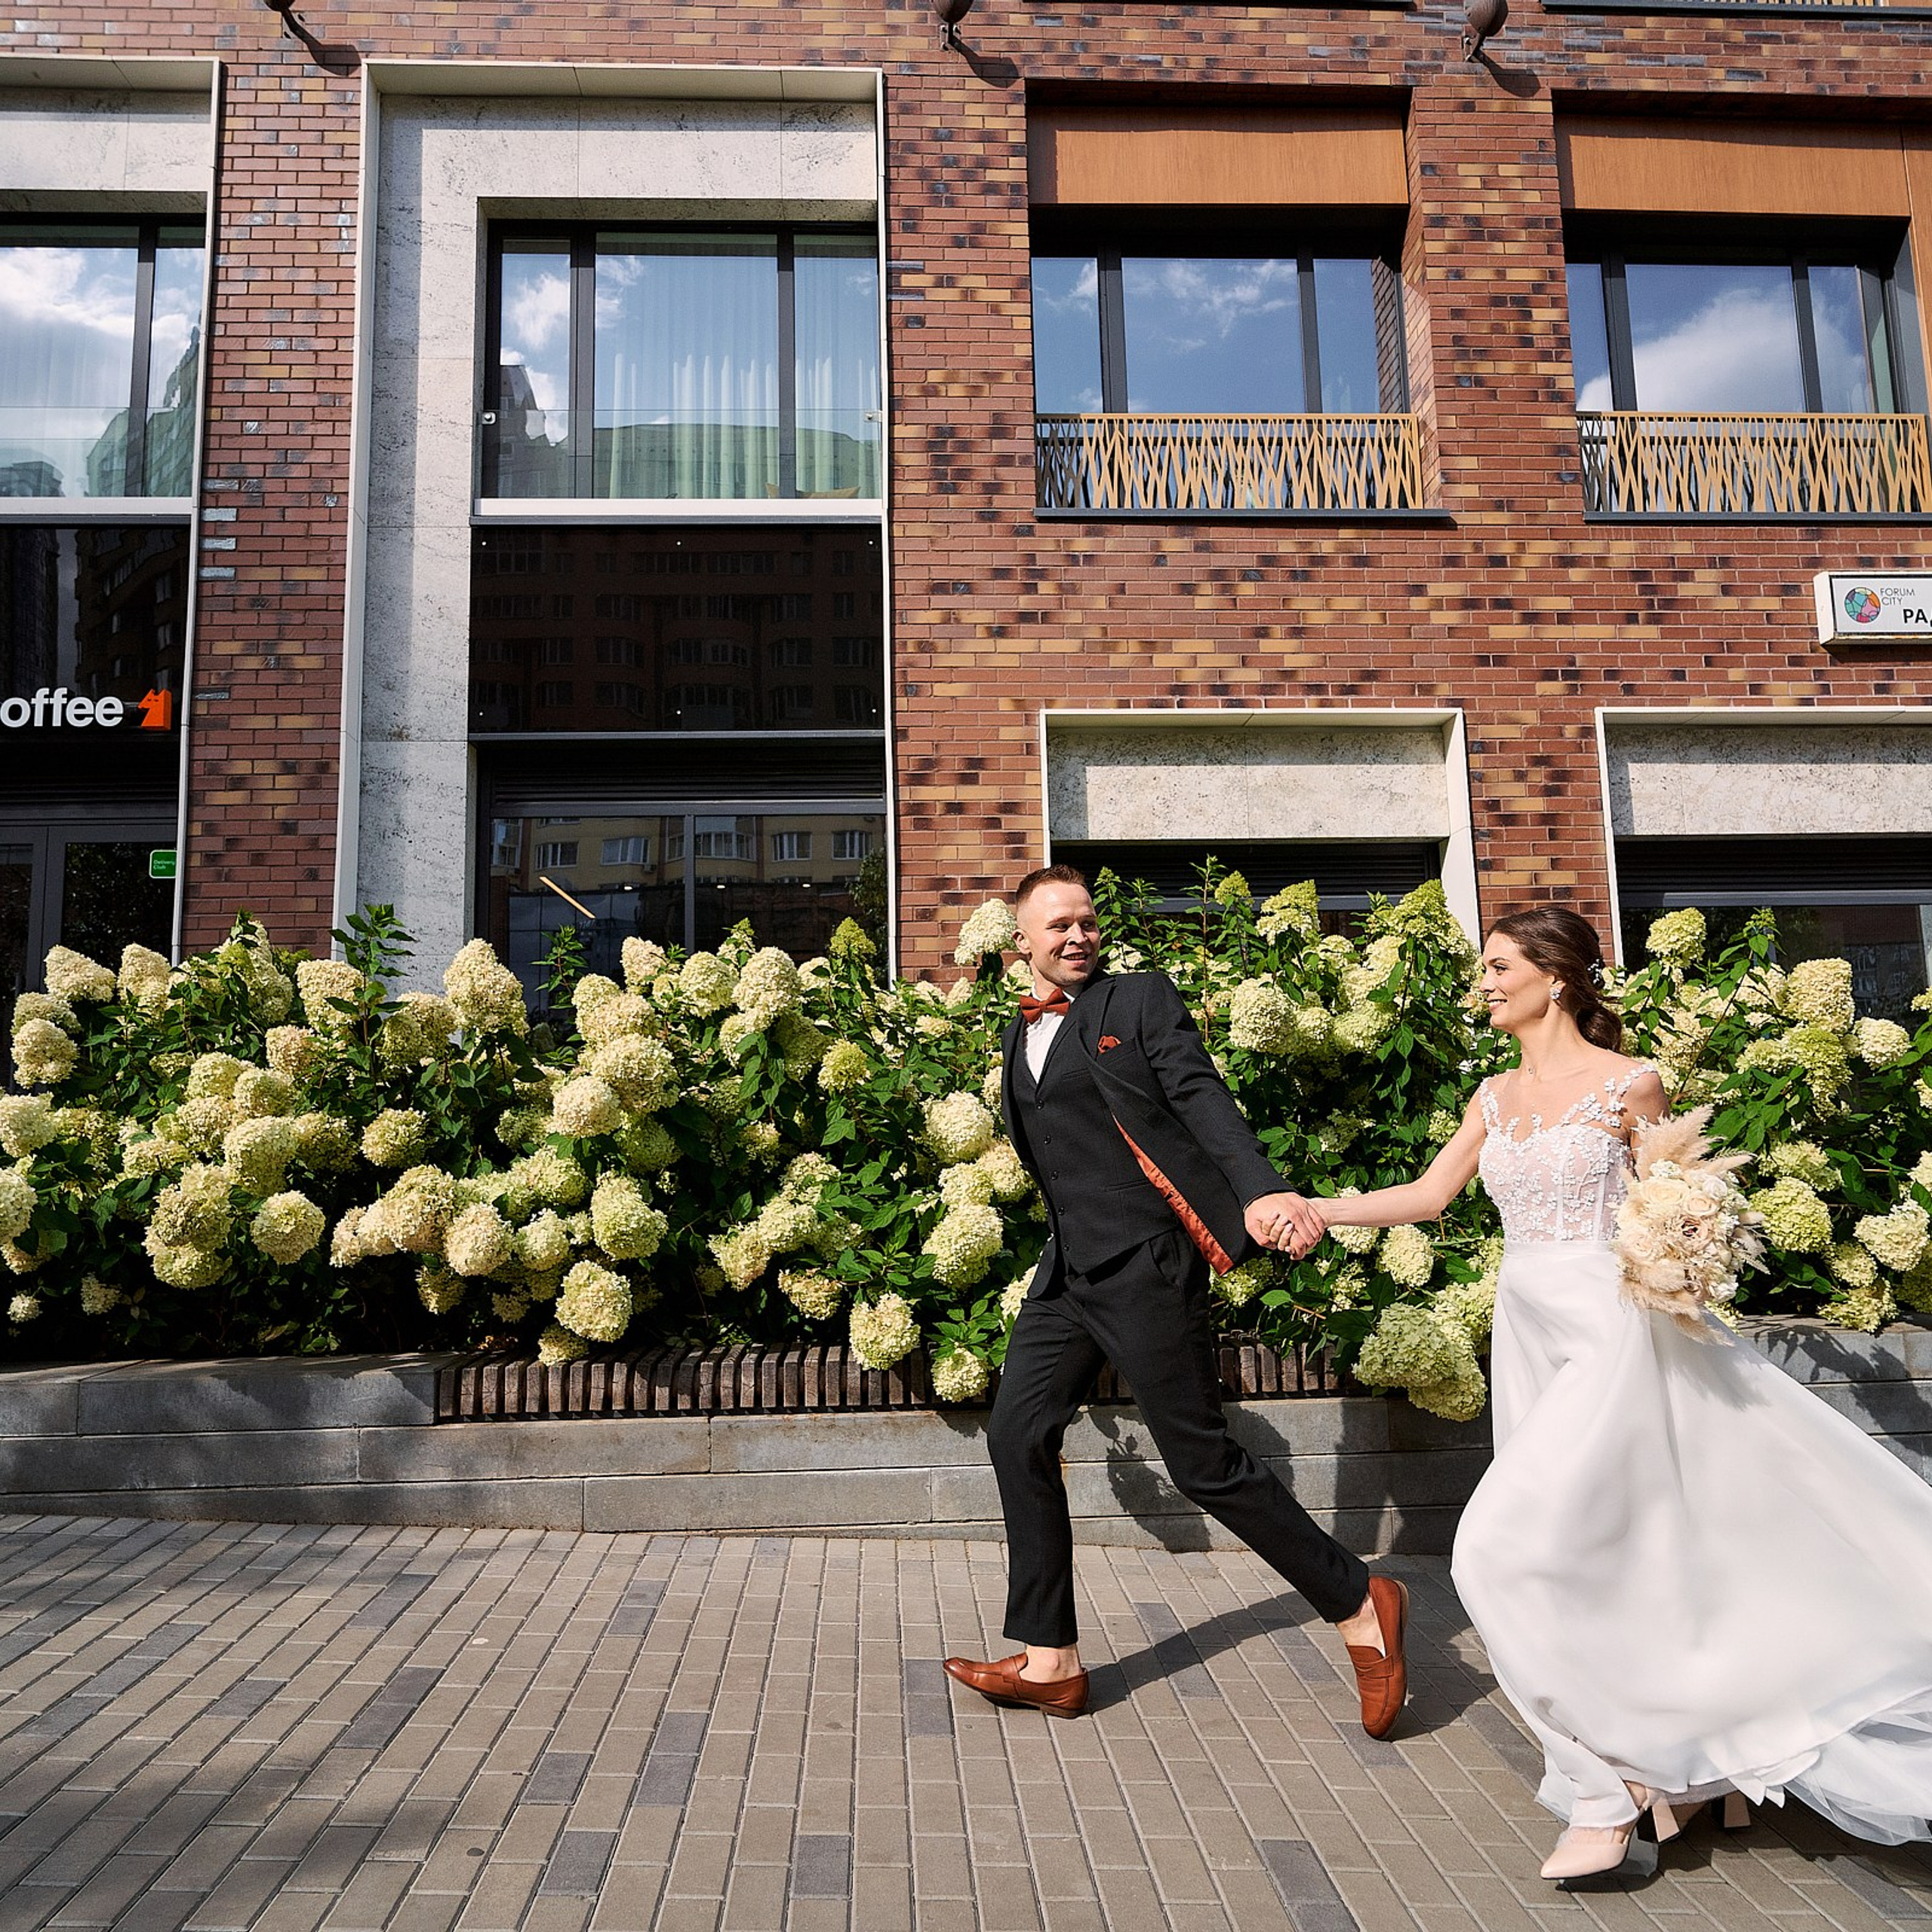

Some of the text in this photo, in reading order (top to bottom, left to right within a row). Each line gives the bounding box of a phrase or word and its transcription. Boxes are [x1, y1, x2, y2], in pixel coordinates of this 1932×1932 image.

[1880, 588, 1915, 596] FORUM
[1881, 596, 1903, 605] CITY
[1903, 608, 1932, 627] РА
